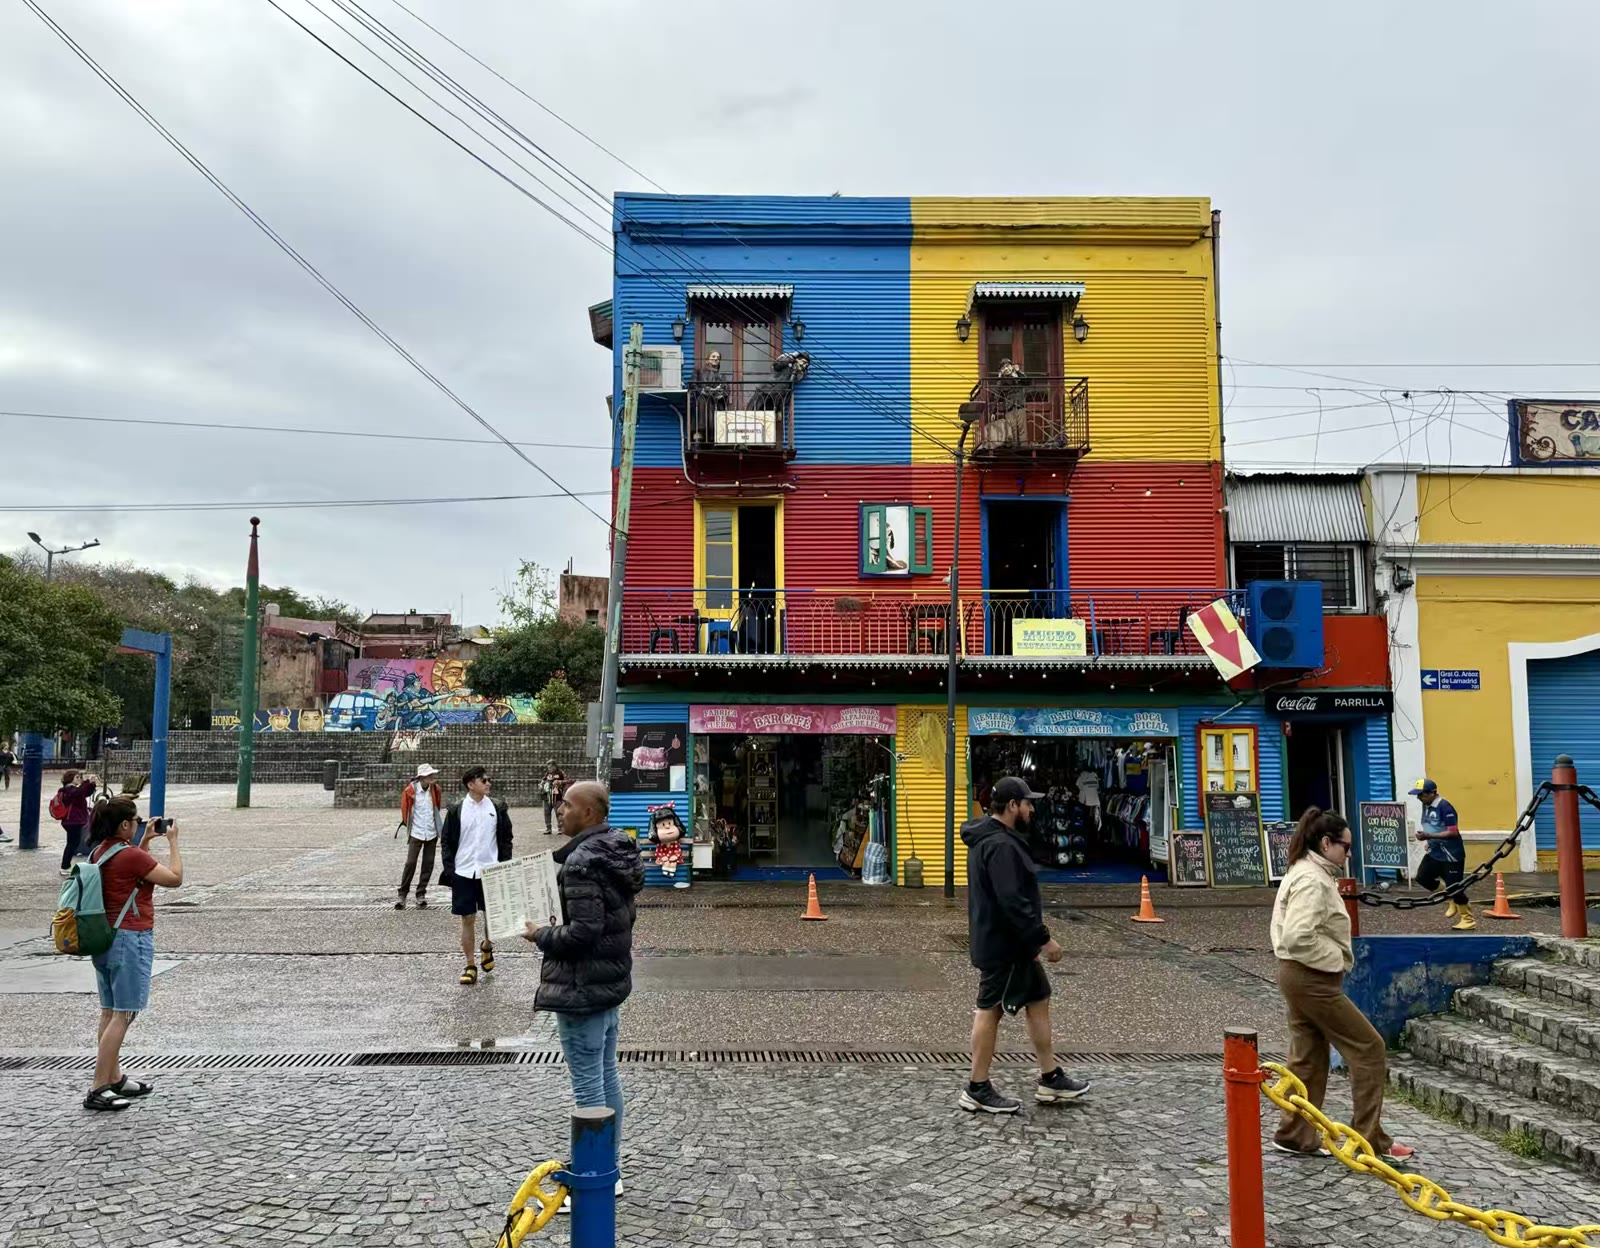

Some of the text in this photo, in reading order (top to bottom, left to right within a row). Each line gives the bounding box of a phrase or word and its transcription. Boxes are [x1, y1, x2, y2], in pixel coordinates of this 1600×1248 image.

[1560, 409, 1600, 430] CA
[1023, 630, 1076, 641] MUSEO
[1334, 698, 1385, 707] PARRILLA
[840, 708, 880, 716] SOUVENIRS
[1049, 709, 1102, 724] BAR CAFÉ
[1134, 712, 1162, 722] BOCA
[753, 714, 813, 729] BAR CAFÉ
[973, 712, 1016, 724] REMERAS
[831, 720, 854, 731] DULCE
[1035, 725, 1113, 734] LANAS CACHEMIR
[1128, 721, 1169, 732] OFICIAL
